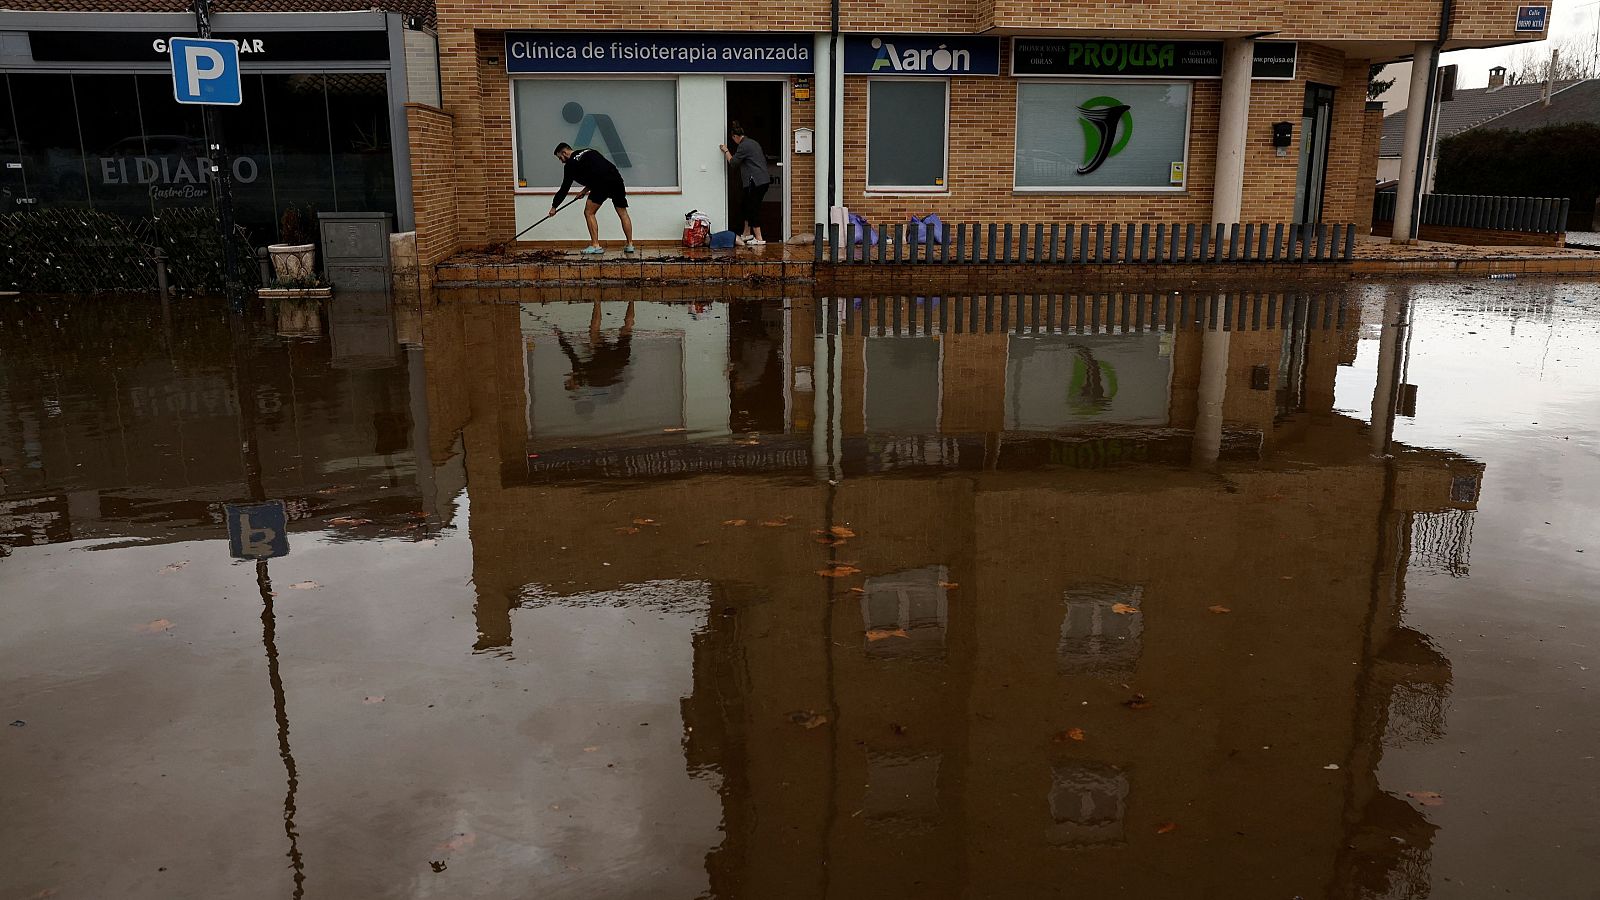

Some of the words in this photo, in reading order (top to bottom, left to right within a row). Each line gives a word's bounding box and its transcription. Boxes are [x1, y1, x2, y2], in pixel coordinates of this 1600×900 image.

[511, 42, 577, 59] Clínica
[582, 42, 605, 59] de
[609, 42, 718, 63] fisioterapia
[721, 43, 809, 60] avanzada
[871, 39, 970, 71] Aarón
[1068, 42, 1177, 71] PROJUSA
[185, 46, 225, 96] P
[134, 156, 258, 184] DIARO
